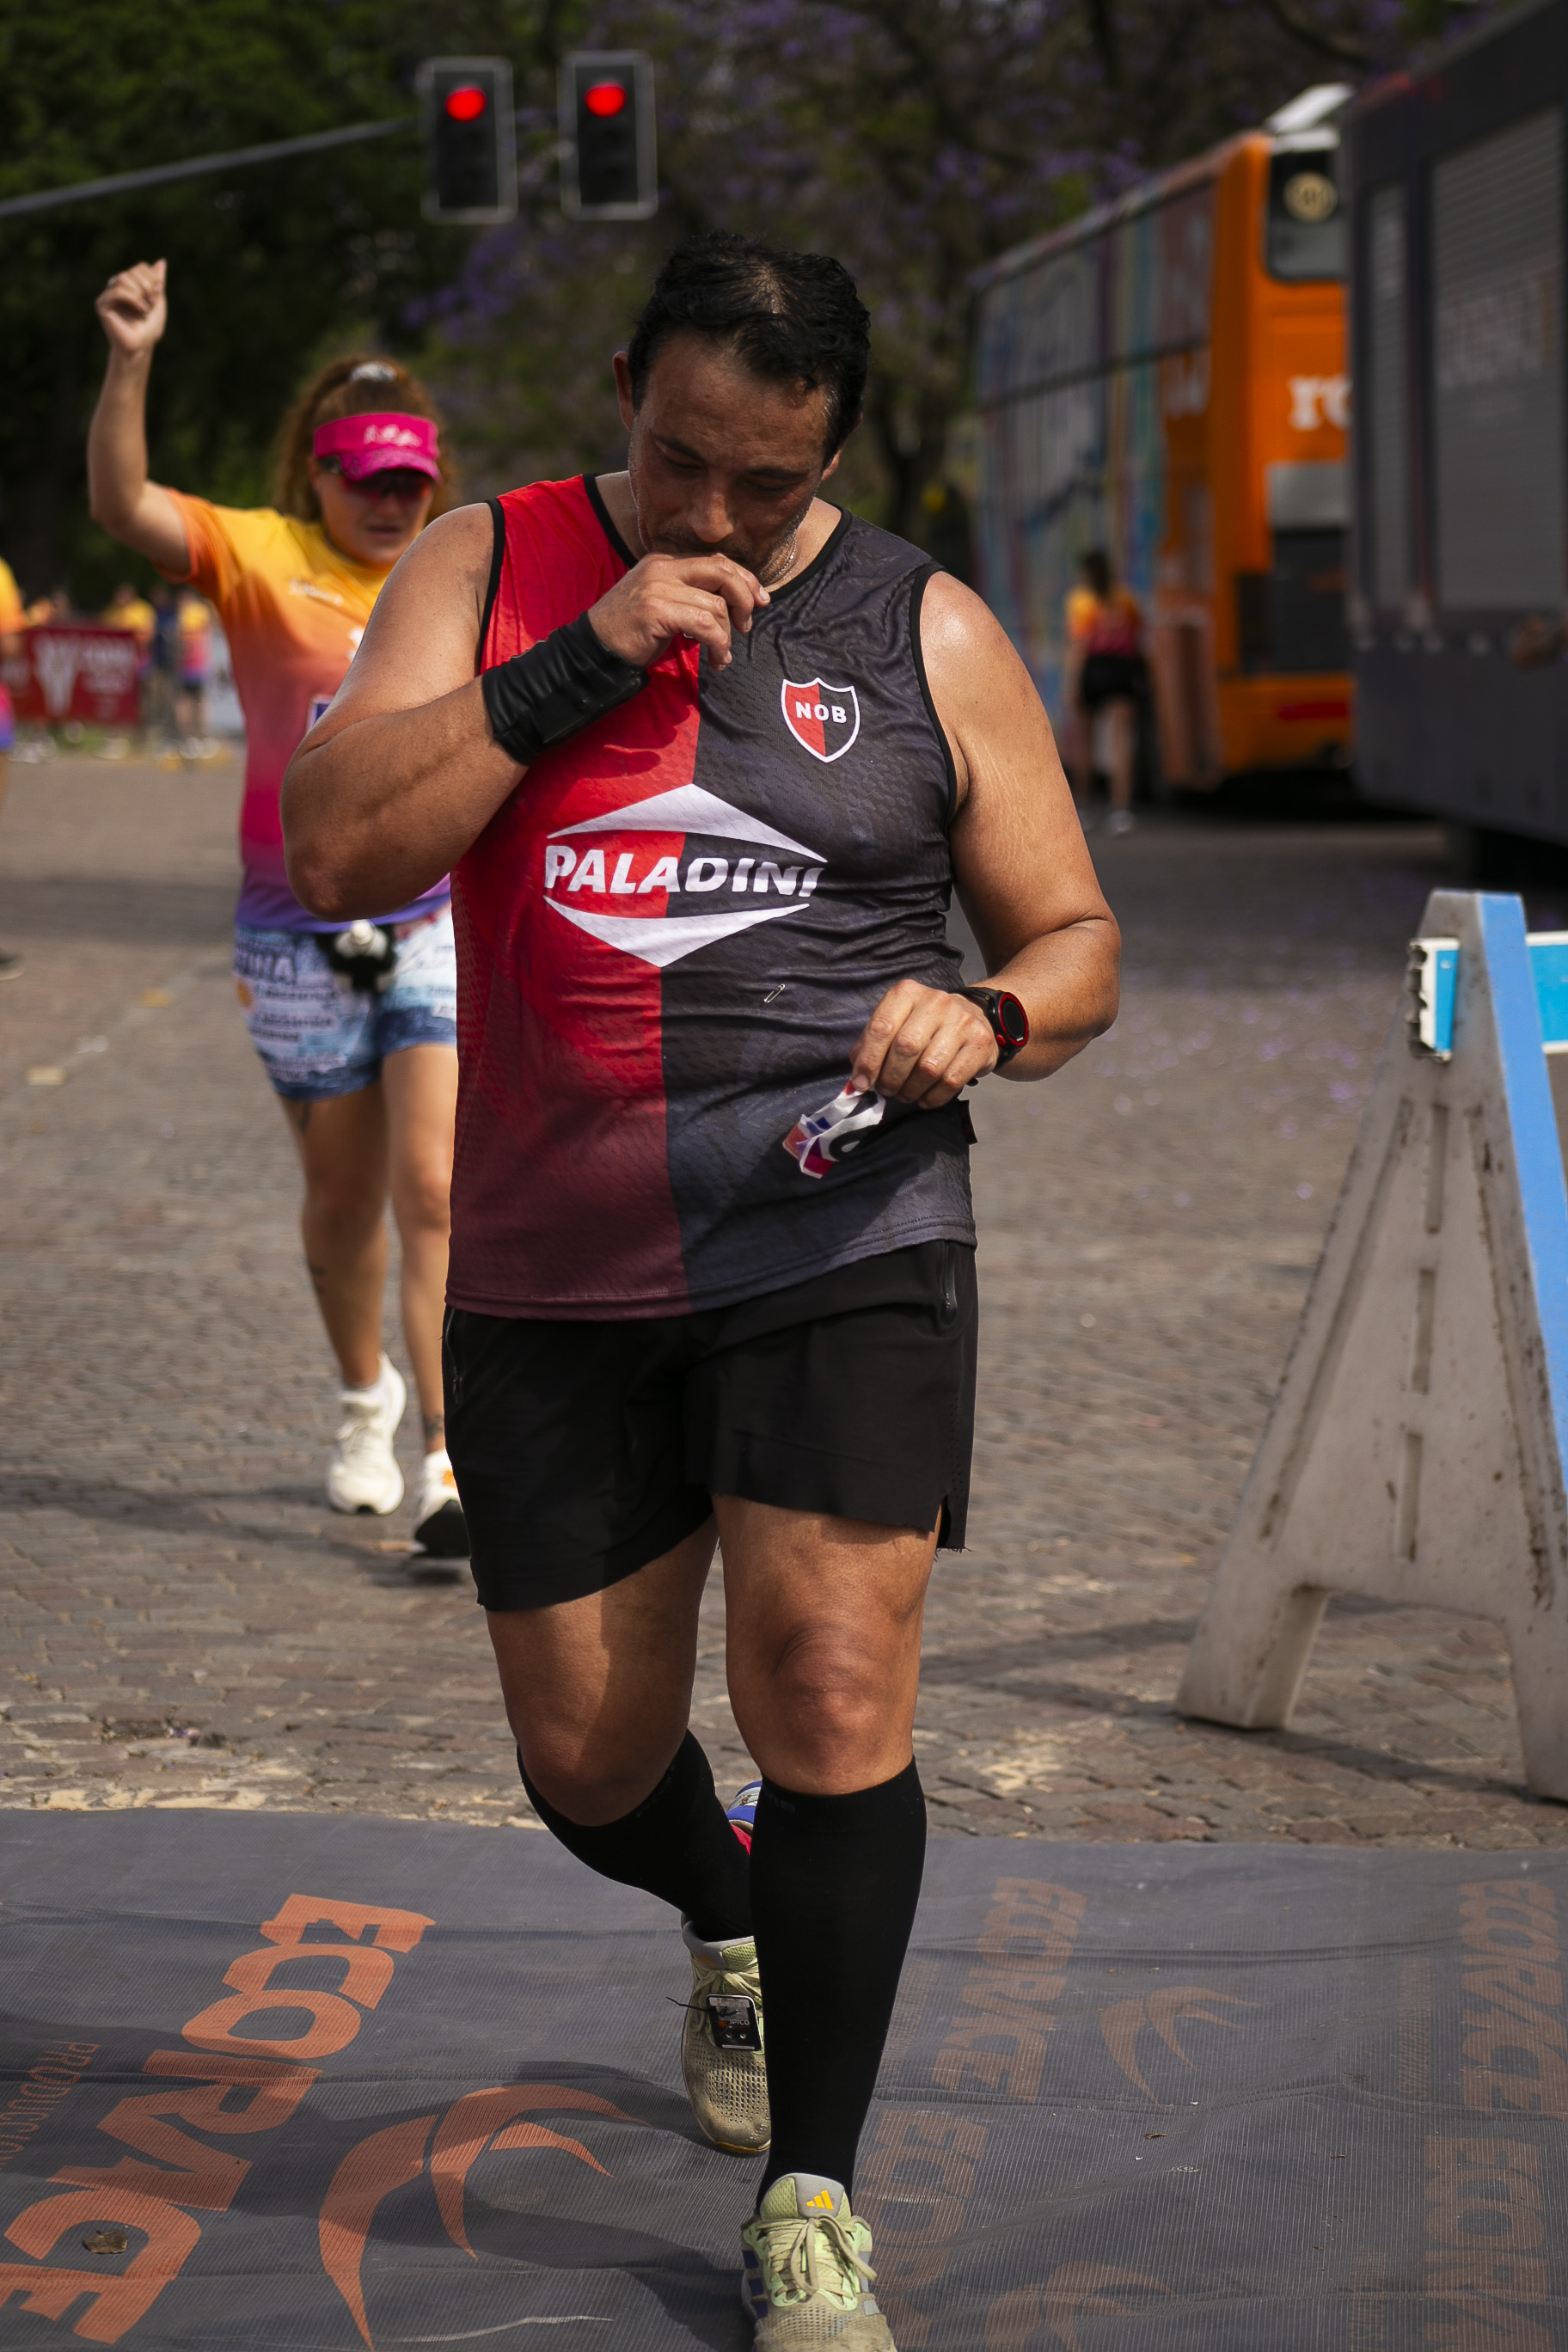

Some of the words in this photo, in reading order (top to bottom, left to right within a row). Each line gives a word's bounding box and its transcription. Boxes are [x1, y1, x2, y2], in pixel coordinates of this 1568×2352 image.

[795, 701, 848, 725] NOB
[544, 845, 825, 897] PALADINI
[0, 2041, 101, 2171] PRODUCCI
[0, 1894, 437, 2345] ECORACE
[1425, 2135, 1553, 2352] ECORA
